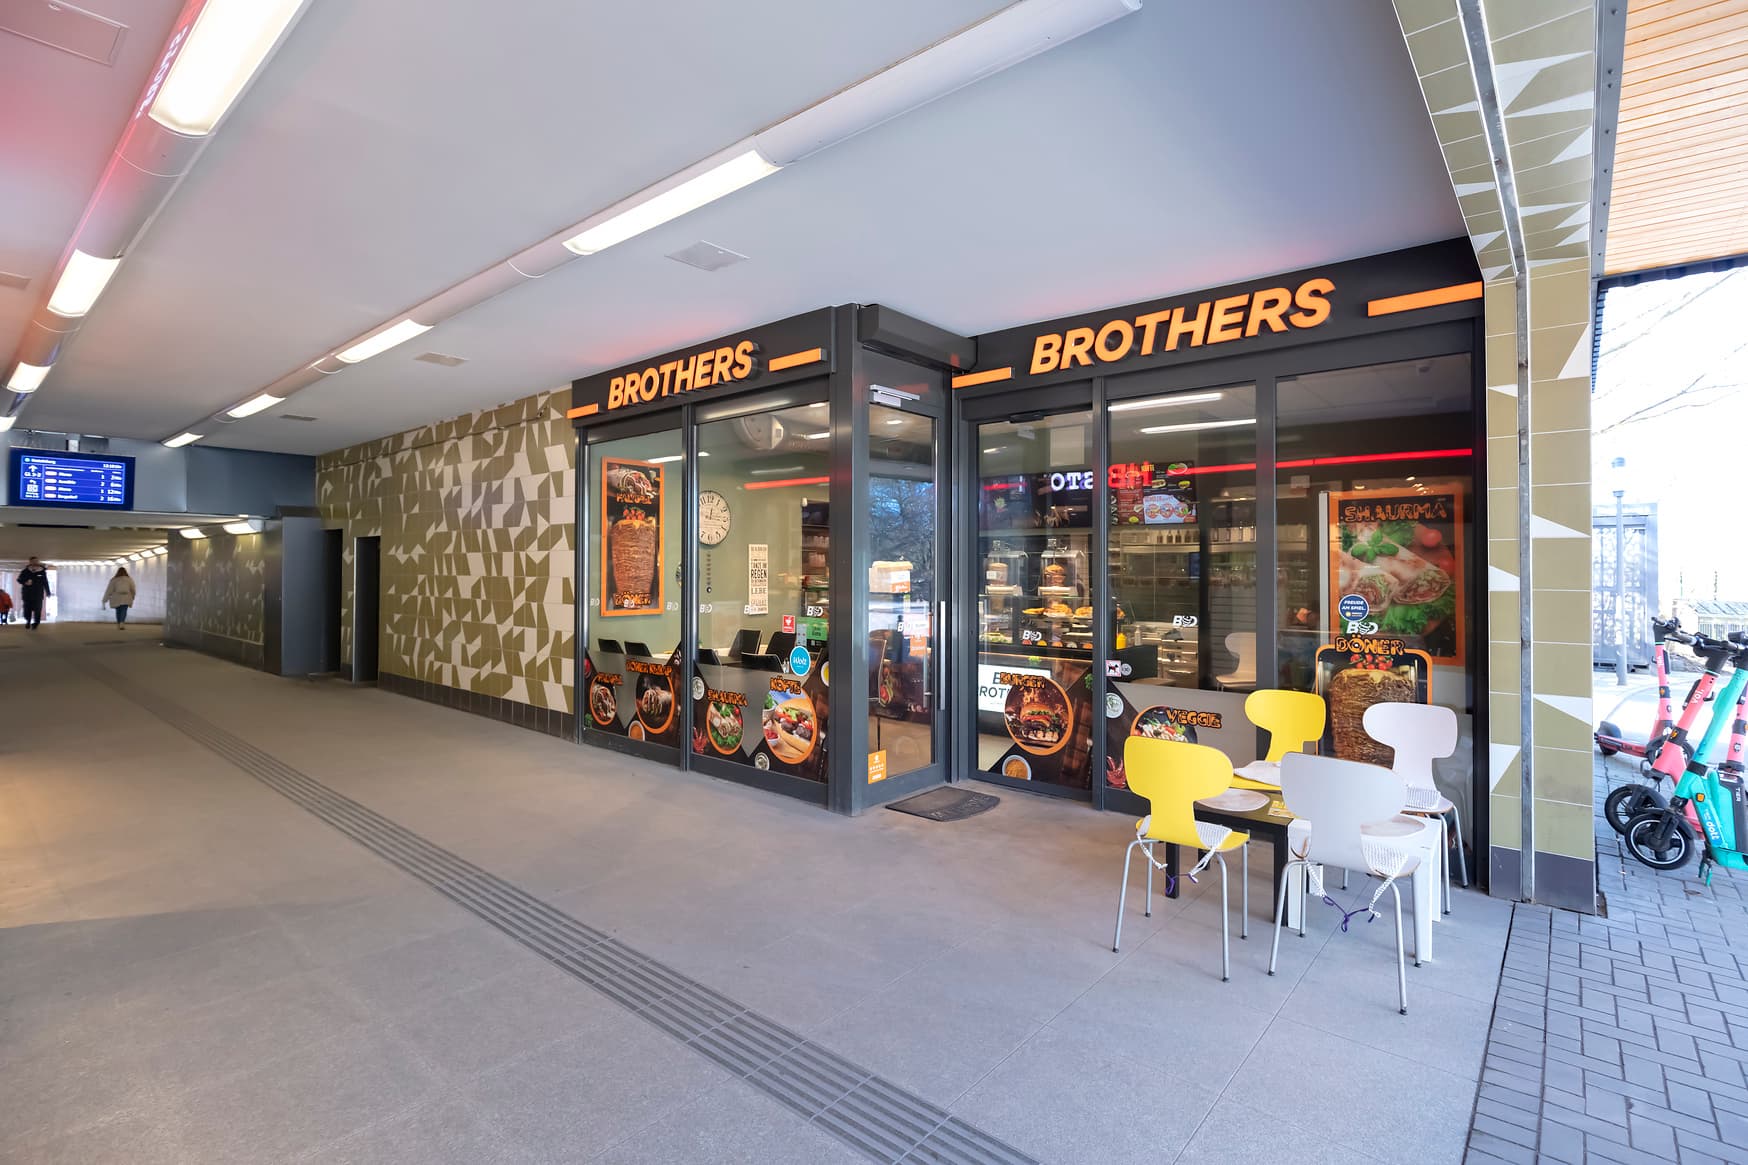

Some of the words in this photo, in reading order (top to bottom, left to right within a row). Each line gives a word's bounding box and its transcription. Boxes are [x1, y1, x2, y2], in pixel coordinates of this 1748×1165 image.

[1029, 278, 1336, 375] BROTHERS
[607, 340, 755, 410] BROTHERS
[1335, 633, 1405, 656] DÖNER
[769, 676, 802, 695] KÖFTE
[1000, 672, 1046, 689] BURGER
[1166, 707, 1223, 729] VEGGIE
[1706, 821, 1720, 840] dott
